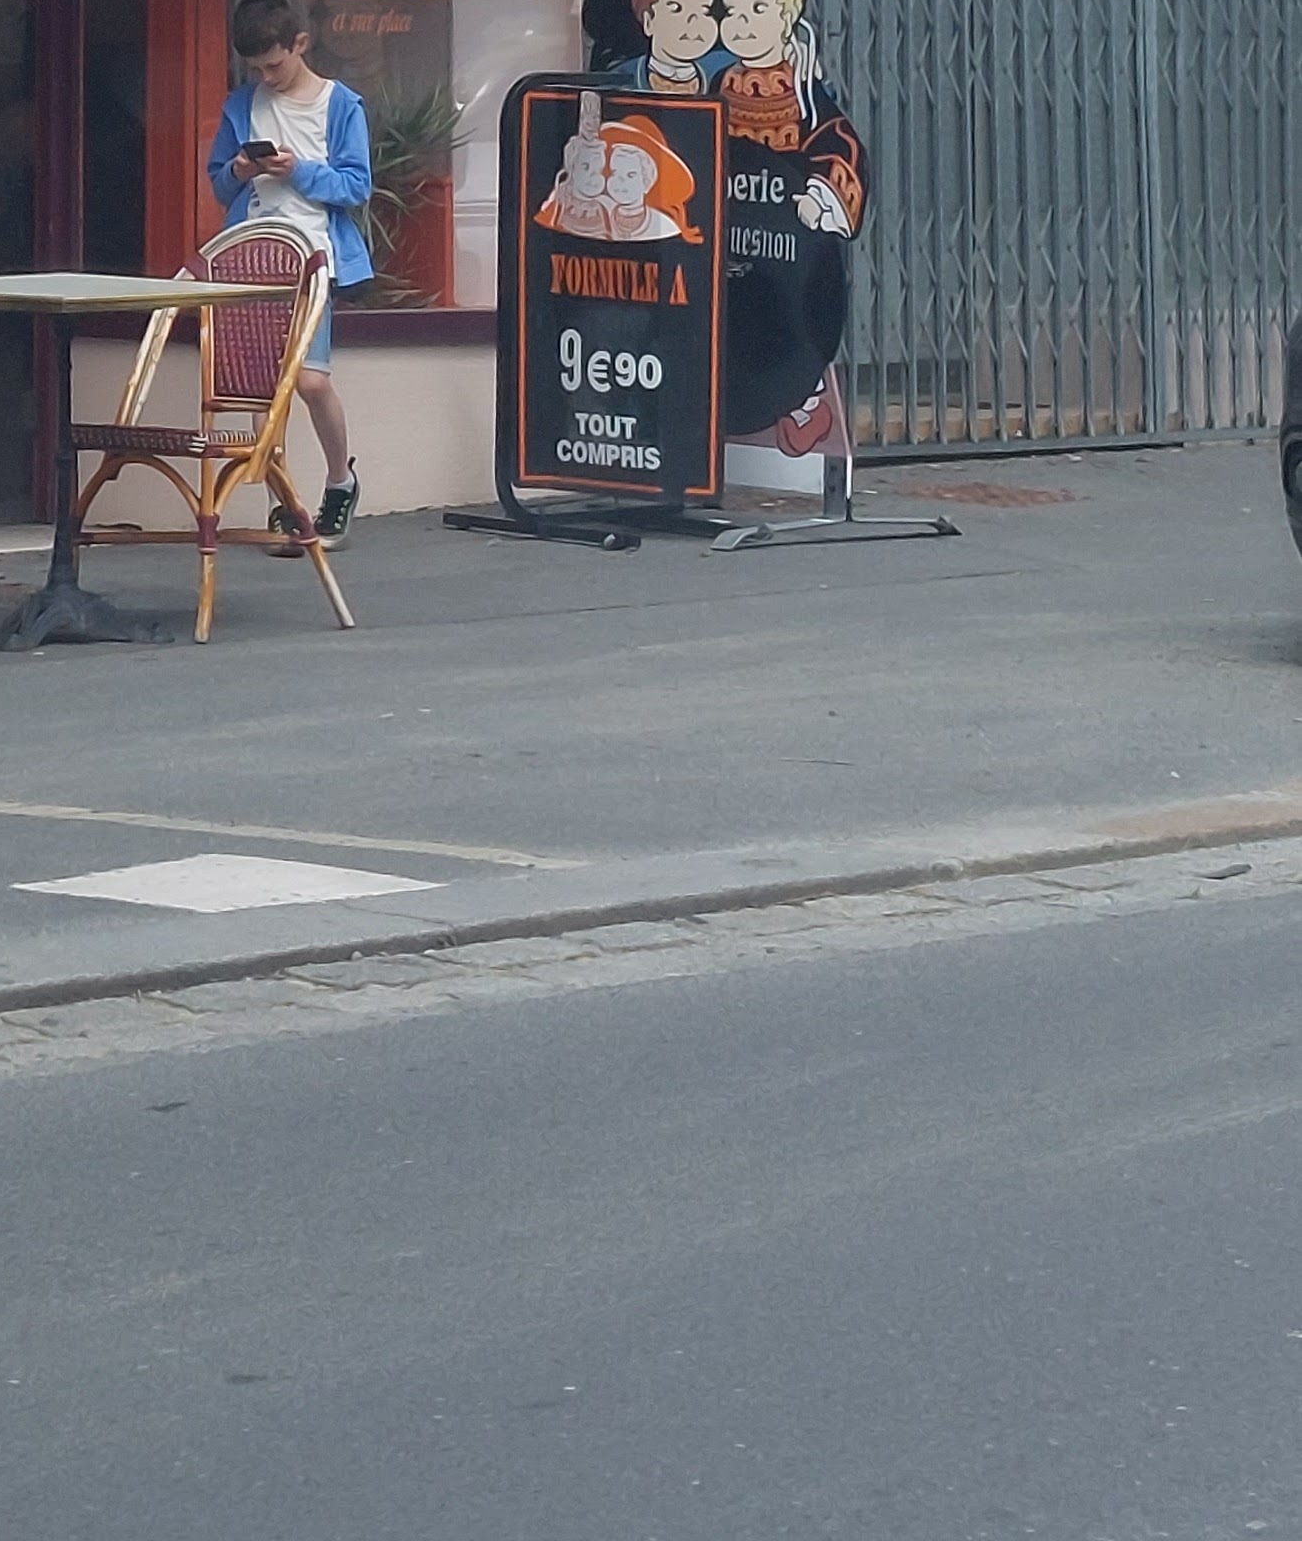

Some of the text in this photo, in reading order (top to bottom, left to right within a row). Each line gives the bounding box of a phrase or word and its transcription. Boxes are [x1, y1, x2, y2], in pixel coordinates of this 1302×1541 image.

[731, 225, 796, 262] uesnon
[550, 253, 689, 306] FORMULE A
[559, 328, 664, 394] 9€90
[574, 411, 638, 441] TOUT
[556, 439, 662, 471] COMPRIS
